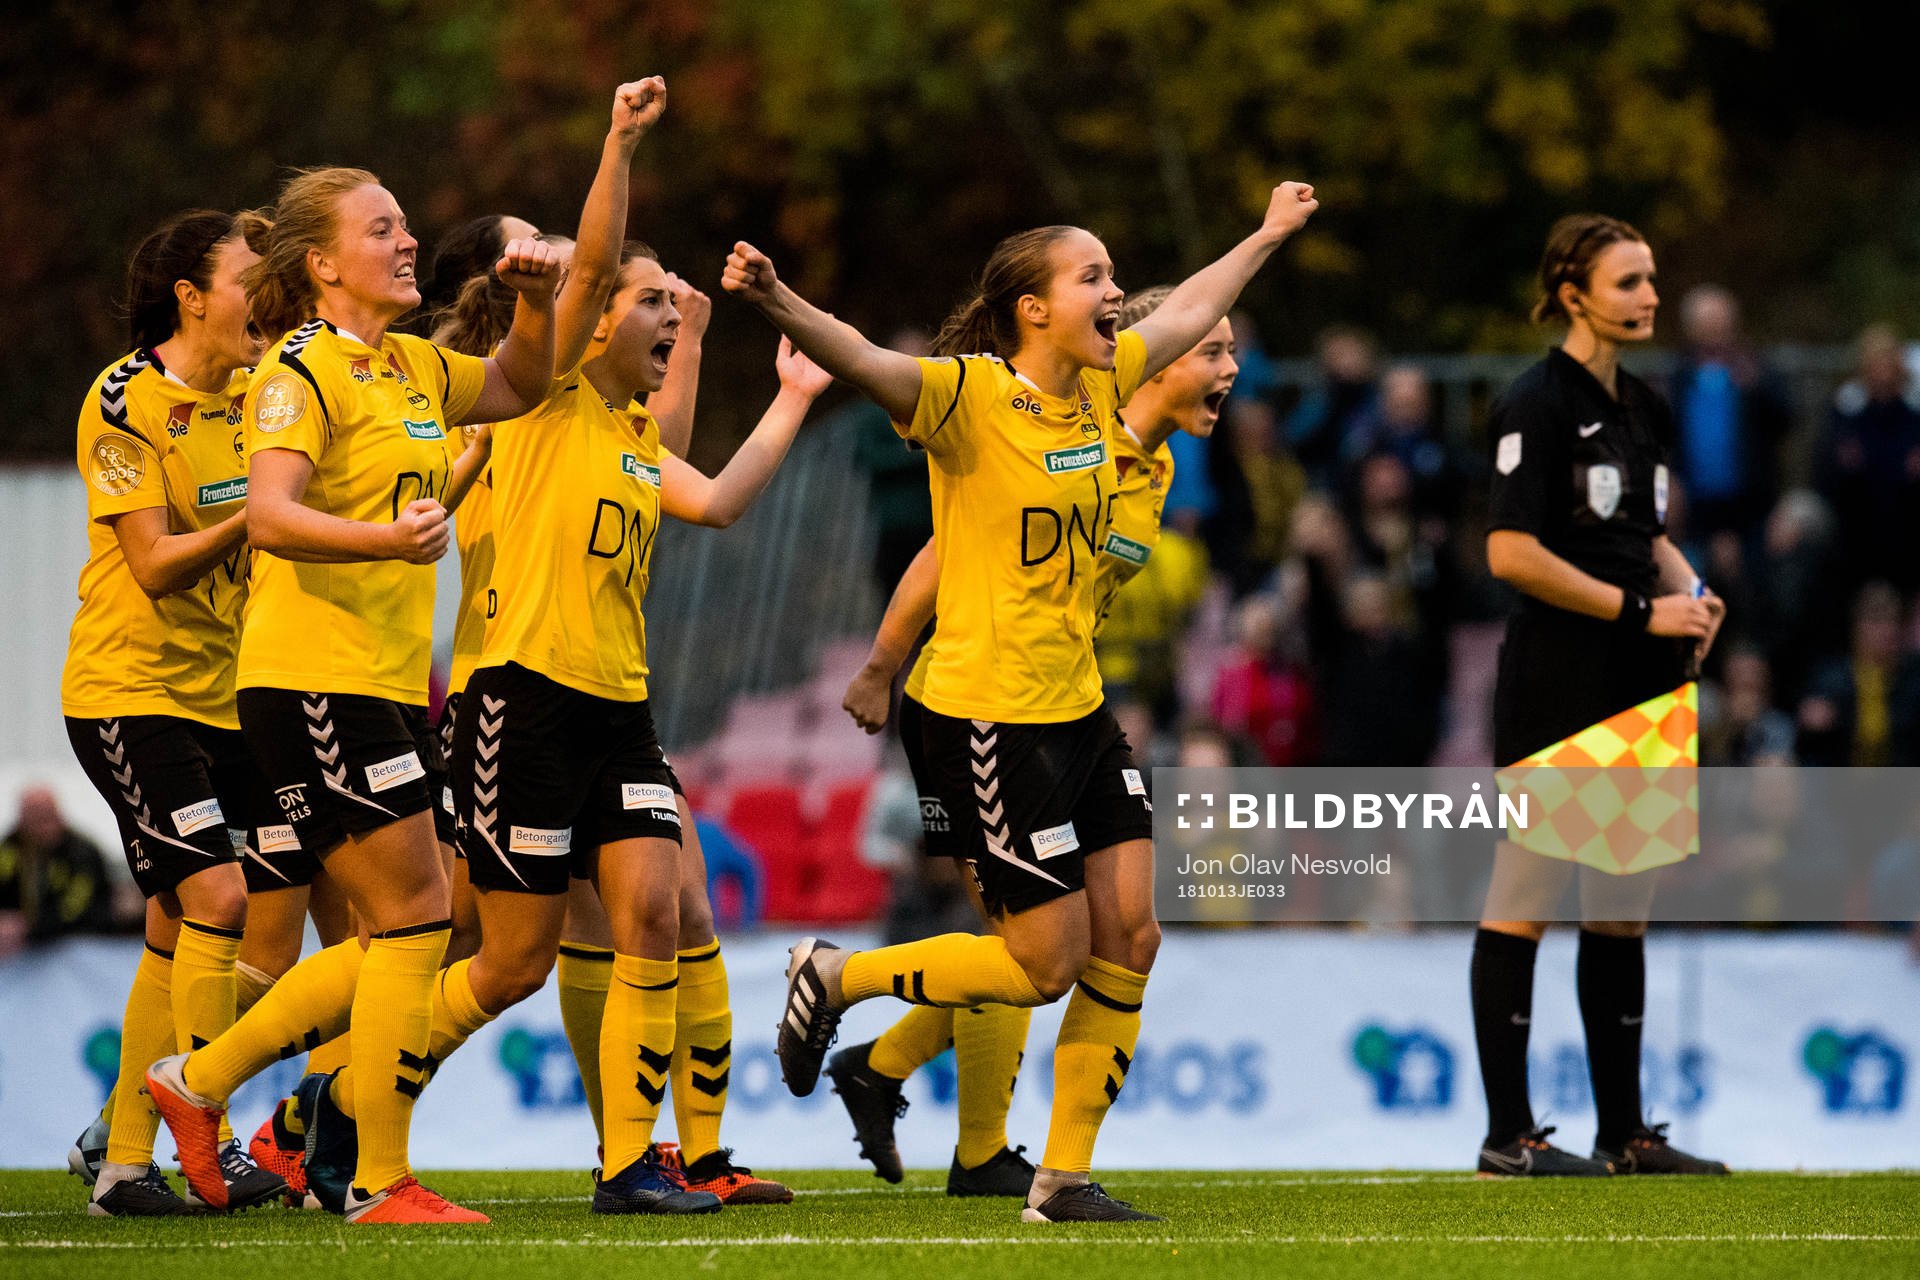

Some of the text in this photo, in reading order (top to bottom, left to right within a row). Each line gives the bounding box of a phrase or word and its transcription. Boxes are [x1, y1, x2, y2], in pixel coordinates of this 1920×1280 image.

[200, 408, 226, 421] hummel
[259, 404, 295, 420] OBOS
[1049, 450, 1101, 470] Franzefoss
[99, 466, 137, 482] OBOS
